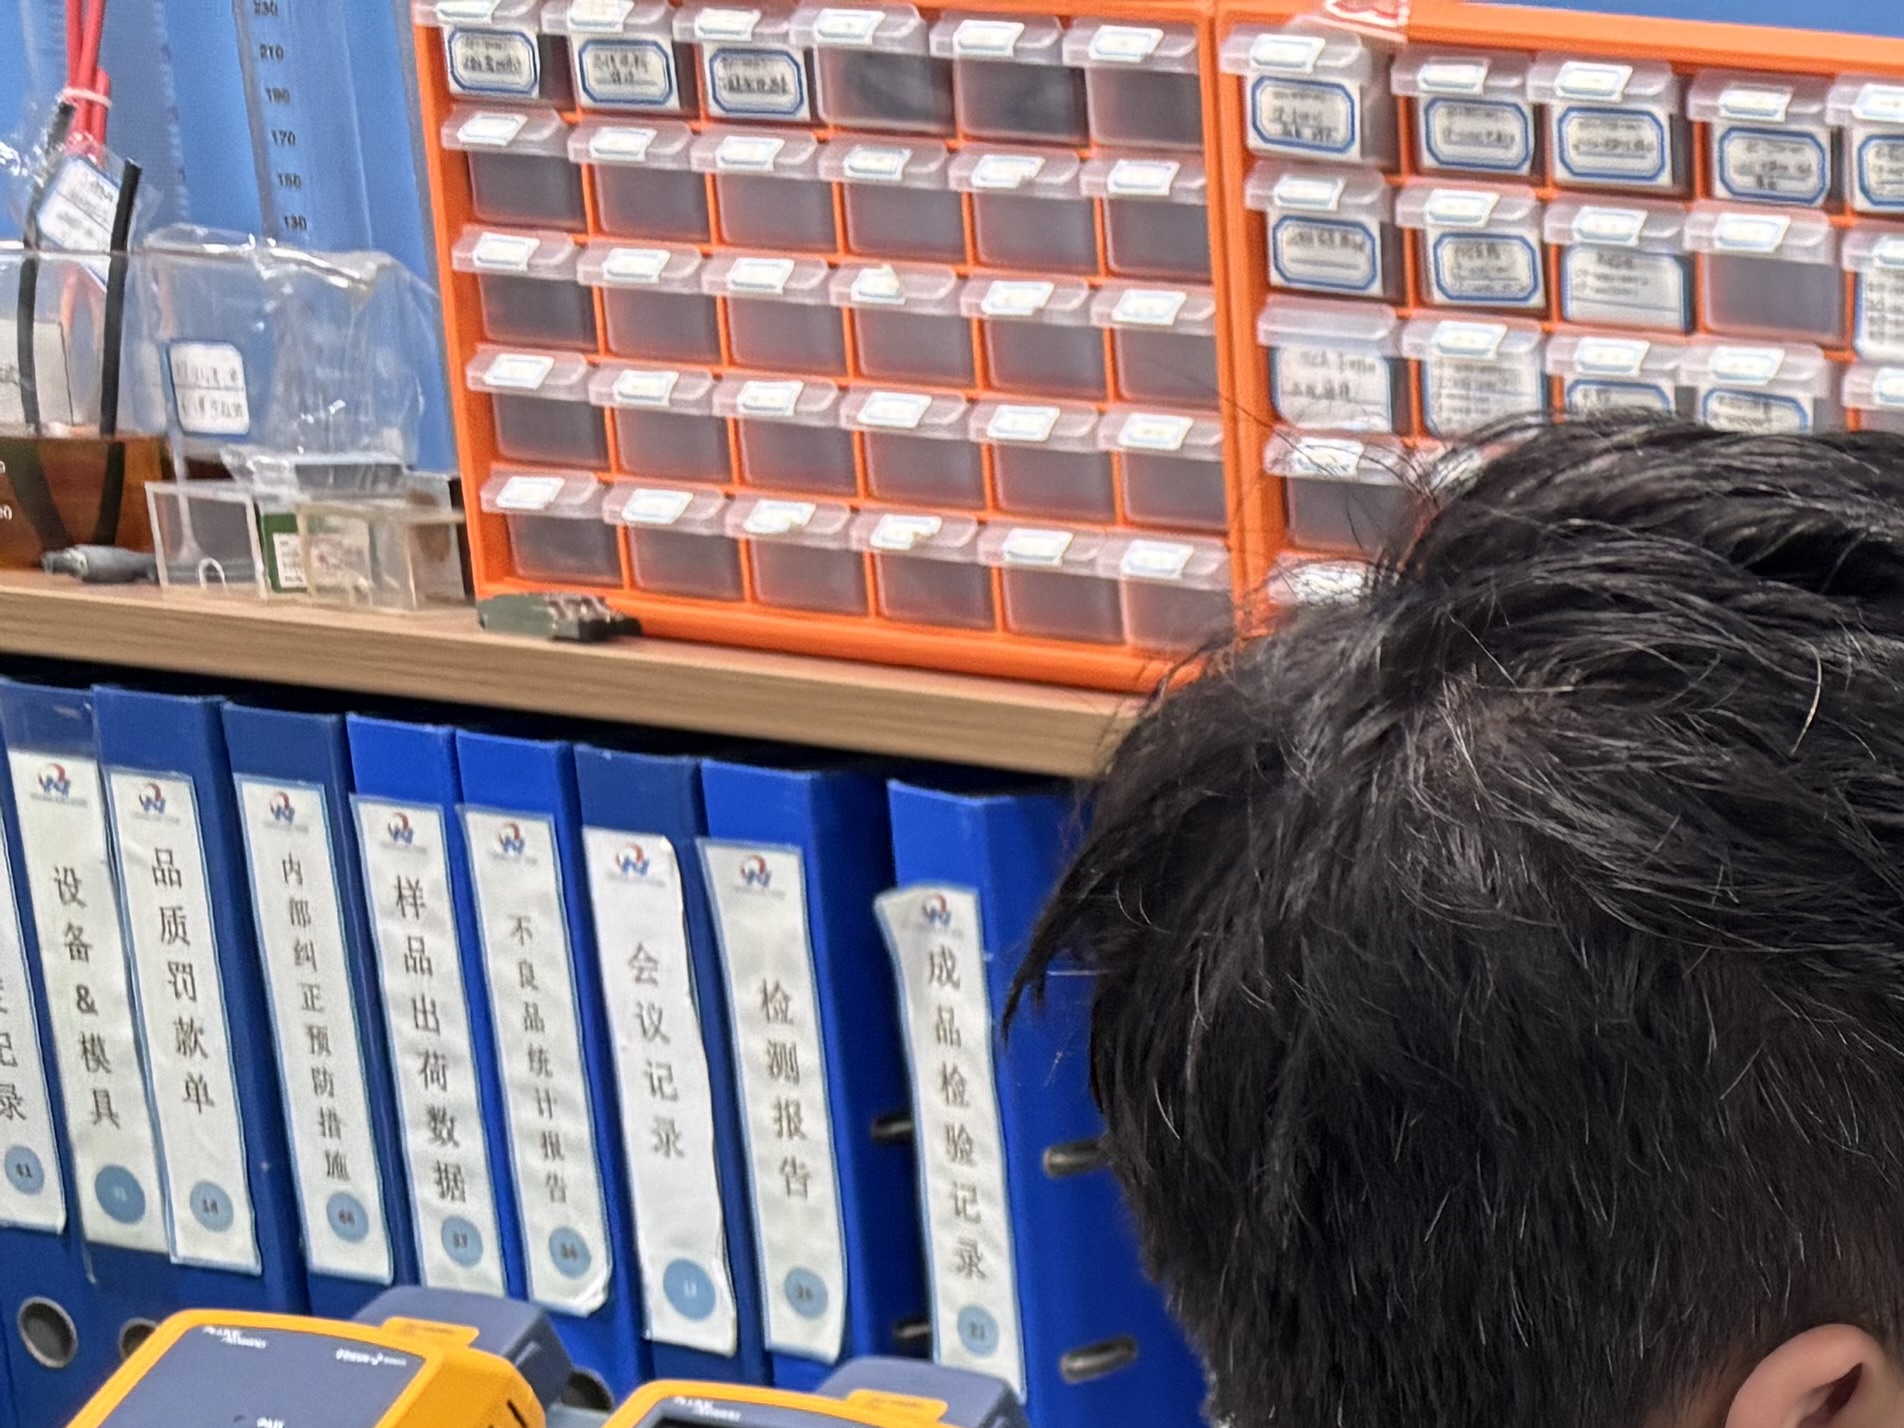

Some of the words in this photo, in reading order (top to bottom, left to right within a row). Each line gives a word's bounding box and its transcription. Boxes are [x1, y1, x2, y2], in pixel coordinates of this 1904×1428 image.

[52, 865, 120, 1130] 设备&模具
[151, 847, 216, 1115] 品质罚款单
[281, 851, 351, 1183] 内部纠正预防措施
[395, 873, 466, 1204] 样品出荷数据
[508, 913, 567, 1204] 不良品统计报告
[626, 941, 685, 1161] 会议记录
[758, 978, 809, 1200] 检测报告
[927, 949, 988, 1281] 成品检验记录
